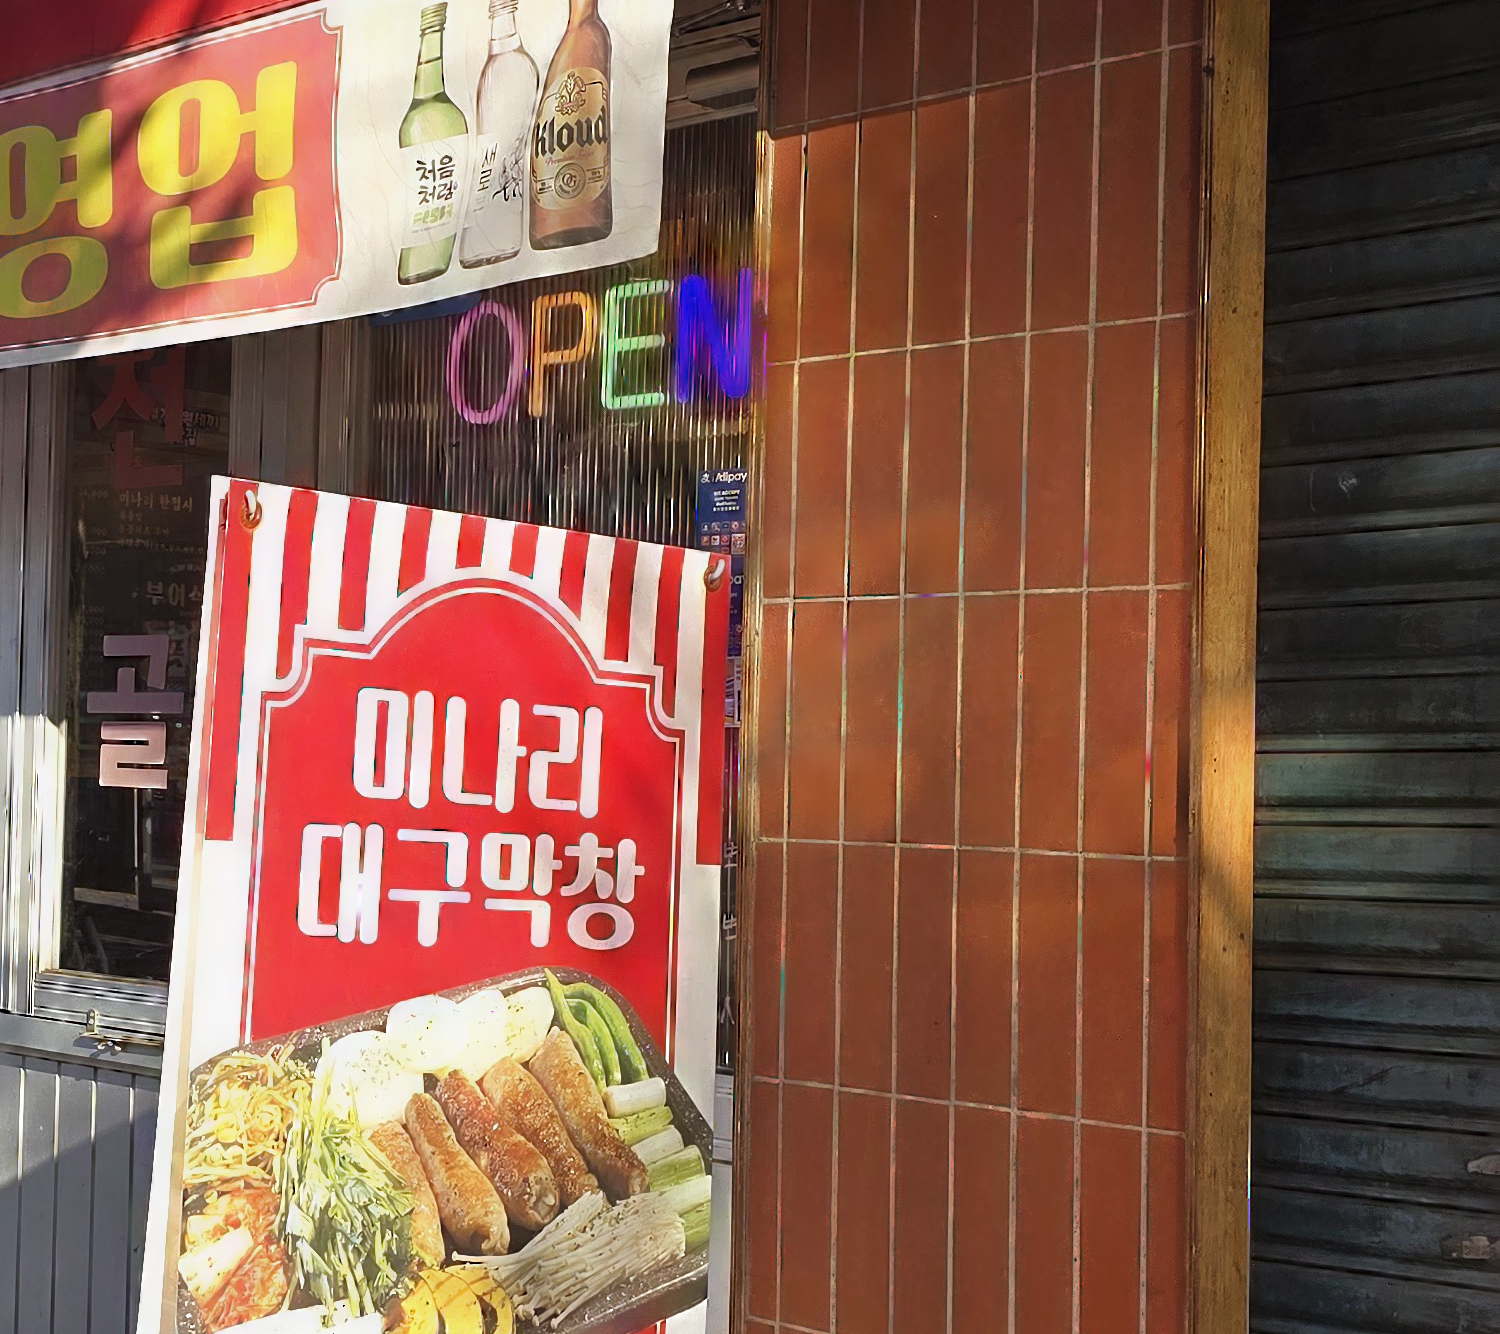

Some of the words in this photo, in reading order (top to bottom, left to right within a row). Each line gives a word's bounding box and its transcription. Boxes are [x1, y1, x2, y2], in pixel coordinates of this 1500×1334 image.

[533, 104, 608, 159] Kloud
[416, 154, 456, 183] 처음
[417, 180, 454, 206] 처럼
[477, 142, 497, 193] 새로
[445, 266, 754, 427] OPEN
[715, 471, 748, 484] Alipay
[352, 687, 603, 819] 미나리
[297, 822, 646, 951] 대구막창
